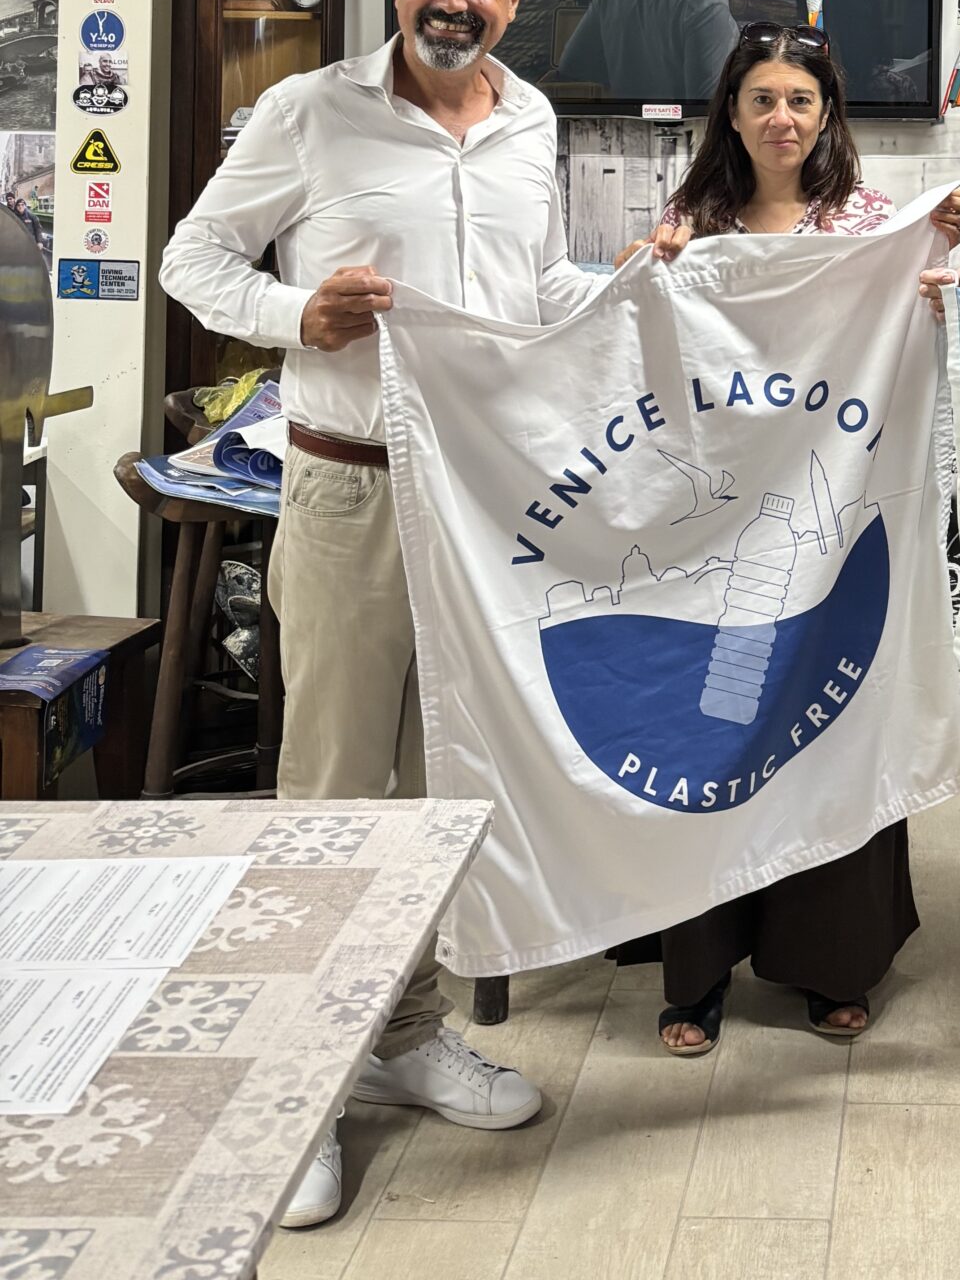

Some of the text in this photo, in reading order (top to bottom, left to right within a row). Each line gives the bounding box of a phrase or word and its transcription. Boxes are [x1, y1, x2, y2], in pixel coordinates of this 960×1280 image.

[90, 33, 116, 42] Y-40
[88, 199, 109, 208] DAN
[511, 371, 884, 565] VENICE LAGOO
[618, 657, 863, 808] PLASTIC FREE
